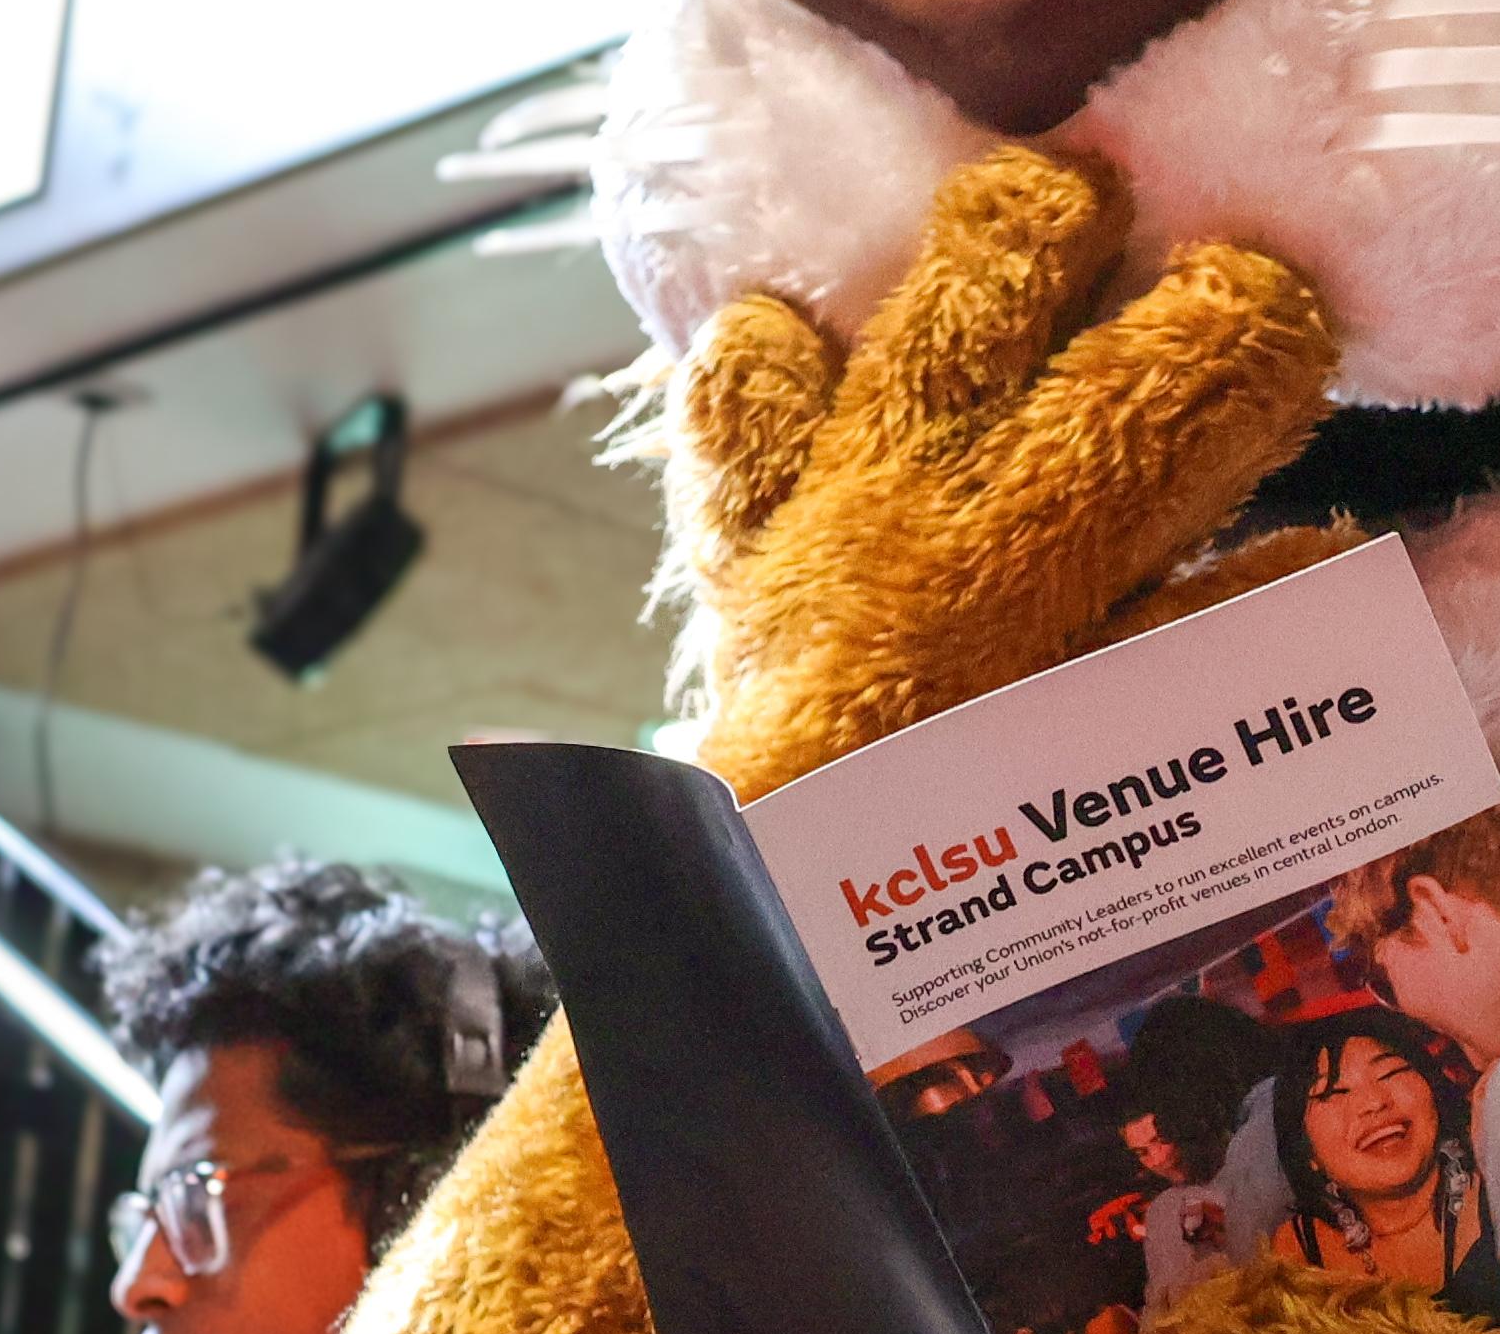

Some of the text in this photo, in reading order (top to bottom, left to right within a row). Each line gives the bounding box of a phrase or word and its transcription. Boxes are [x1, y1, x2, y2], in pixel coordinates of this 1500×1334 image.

[839, 686, 1377, 927] kclsu Venue Hire
[865, 810, 1202, 966] Strand Campus
[891, 773, 1444, 1007] Supporting Community Leaders to run excellent events on campus.
[899, 813, 1402, 1024] Discover your Union's not-for-profit venues in central London.
